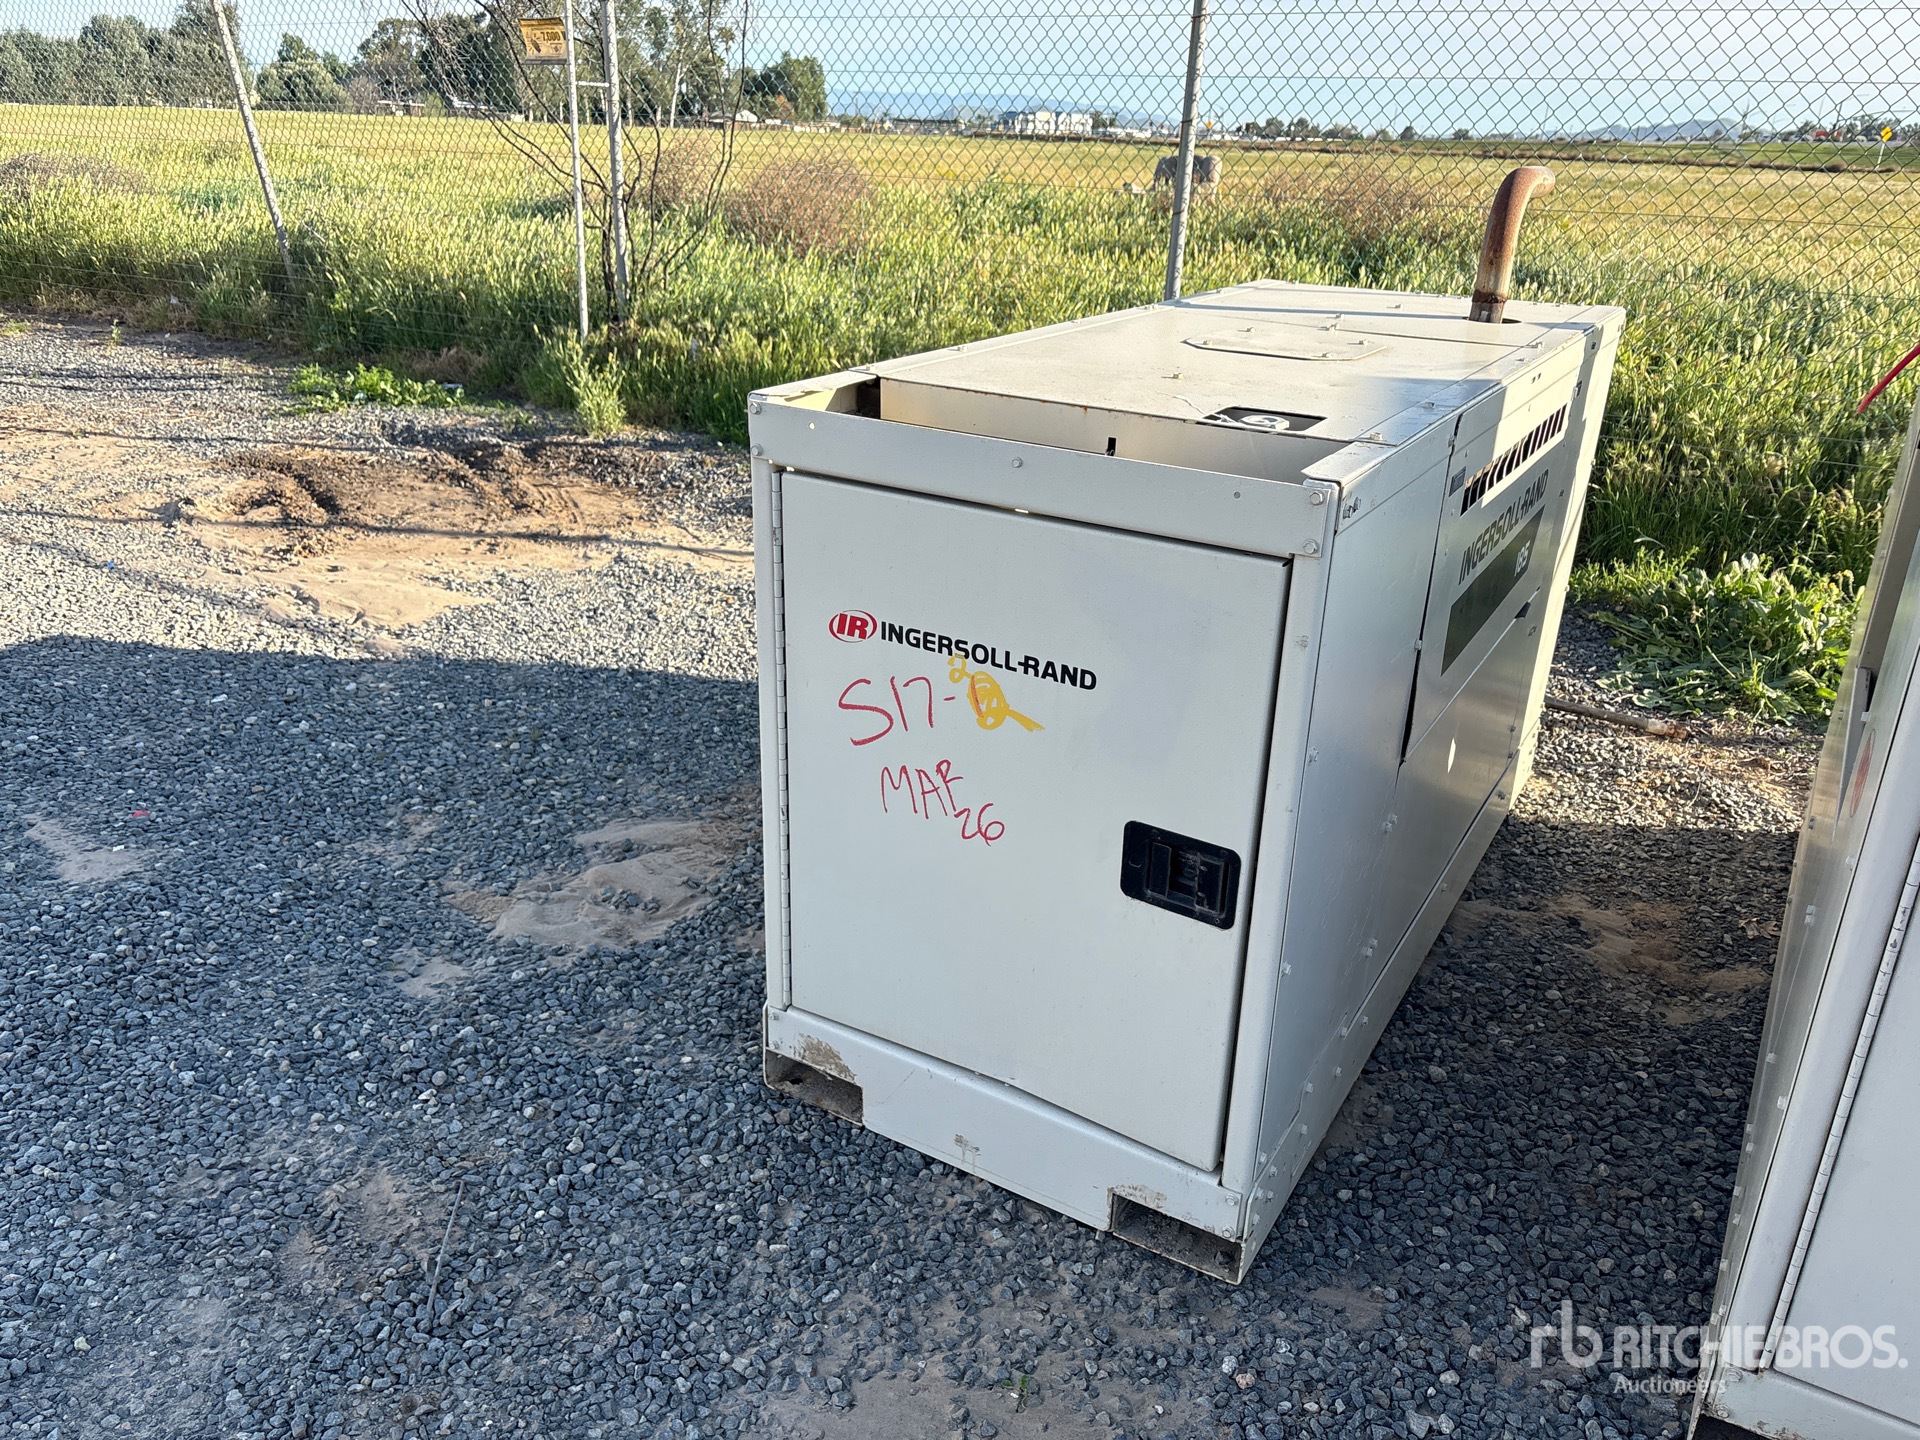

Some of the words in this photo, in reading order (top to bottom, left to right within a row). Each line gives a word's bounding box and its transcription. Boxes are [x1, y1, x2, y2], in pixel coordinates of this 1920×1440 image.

[1458, 469, 1549, 585] INGERSOLL-RAND
[881, 621, 1098, 691] INGERSOLL-RAND
[880, 758, 964, 820] MAR
[954, 803, 1006, 847] 26
